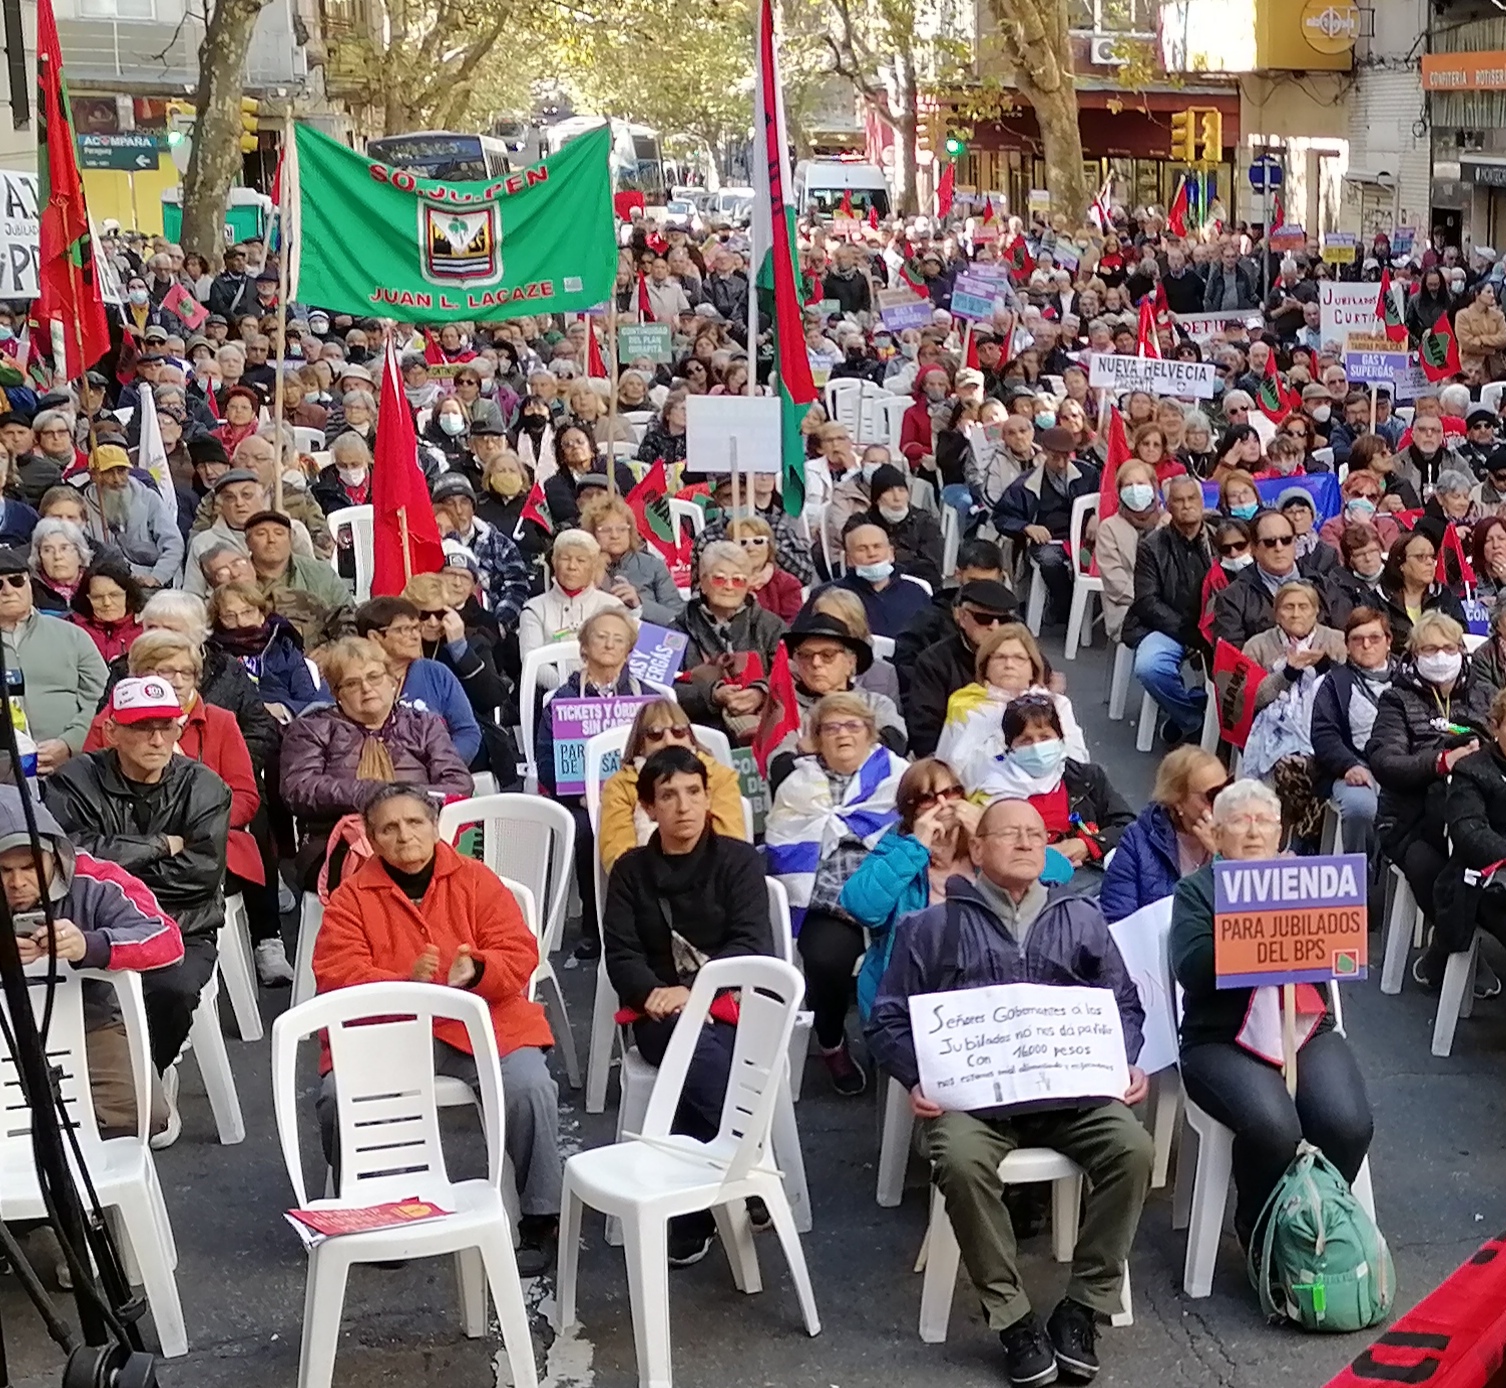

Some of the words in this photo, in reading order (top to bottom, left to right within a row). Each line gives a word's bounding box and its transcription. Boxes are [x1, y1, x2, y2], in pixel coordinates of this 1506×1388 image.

[369, 287, 431, 307] JUAN
[468, 281, 554, 307] LACAZE
[1098, 356, 1138, 374] NUEVA
[1143, 361, 1208, 382] HELVECIA
[1350, 363, 1394, 378] SUPERGÁS
[1361, 354, 1380, 365] GAS
[1380, 355, 1387, 366] Y
[645, 644, 674, 682] ERGÁS
[556, 704, 602, 721] TICKETS
[605, 704, 612, 718] Y
[582, 721, 602, 735] SIN
[561, 760, 578, 774] DE
[1221, 864, 1358, 904] VIVIENDA
[1221, 916, 1265, 941] PARA
[1270, 911, 1360, 938] JUBILADOS
[1257, 941, 1289, 963] DEL
[1294, 938, 1326, 961] BPS
[929, 1004, 985, 1034] Señores
[1086, 1002, 1102, 1015] los
[939, 1030, 1011, 1056] Jubilados
[1037, 1026, 1055, 1037] nos
[1053, 1045, 1091, 1058] pesos
